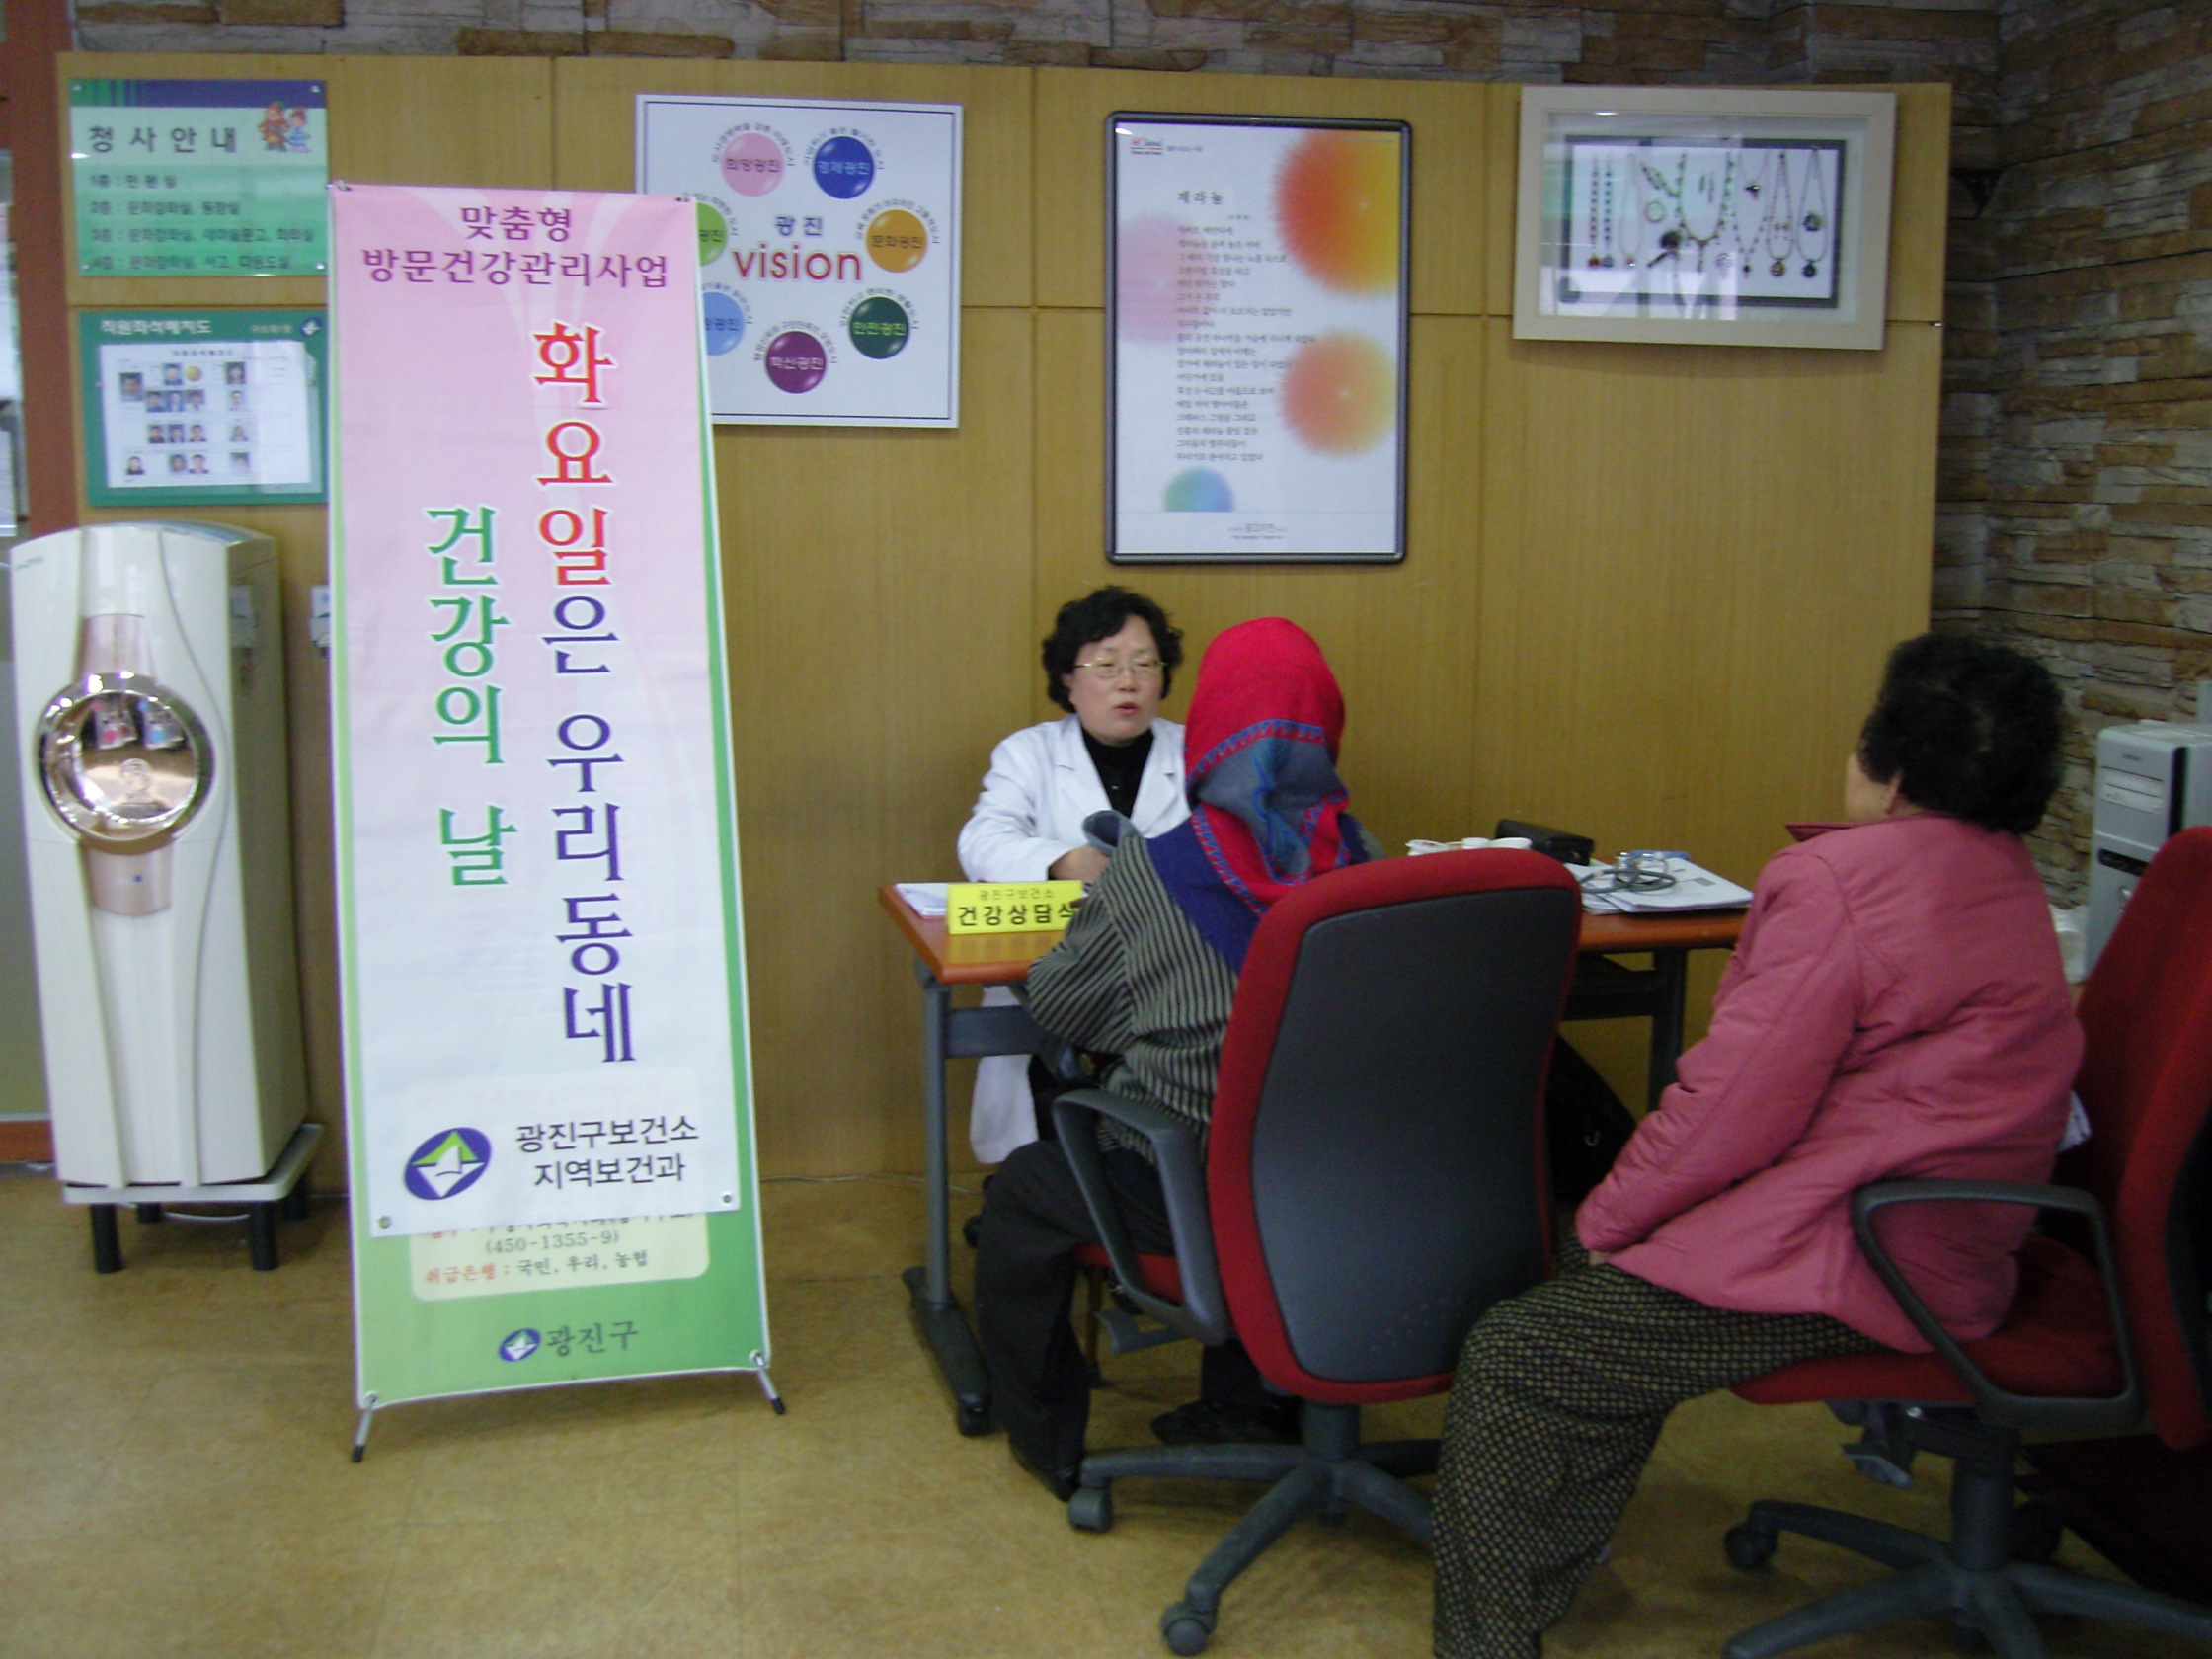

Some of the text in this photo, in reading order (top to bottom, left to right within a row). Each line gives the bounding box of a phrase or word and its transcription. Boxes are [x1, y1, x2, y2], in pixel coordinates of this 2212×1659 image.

[460, 205, 572, 241] 맞춤형
[775, 215, 823, 237] 광진
[363, 249, 668, 288] 방문건강관리사업
[732, 243, 862, 281] vision
[532, 321, 637, 1063] 화요일은 우리동네
[438, 804, 518, 886] 날
[980, 888, 1055, 900] 광진구보건소
[515, 1113, 699, 1152] 광진구보건소
[533, 1153, 686, 1190] 지역보건과
[485, 1229, 620, 1254] (450-1355-9)
[546, 1320, 639, 1357] 광진구
